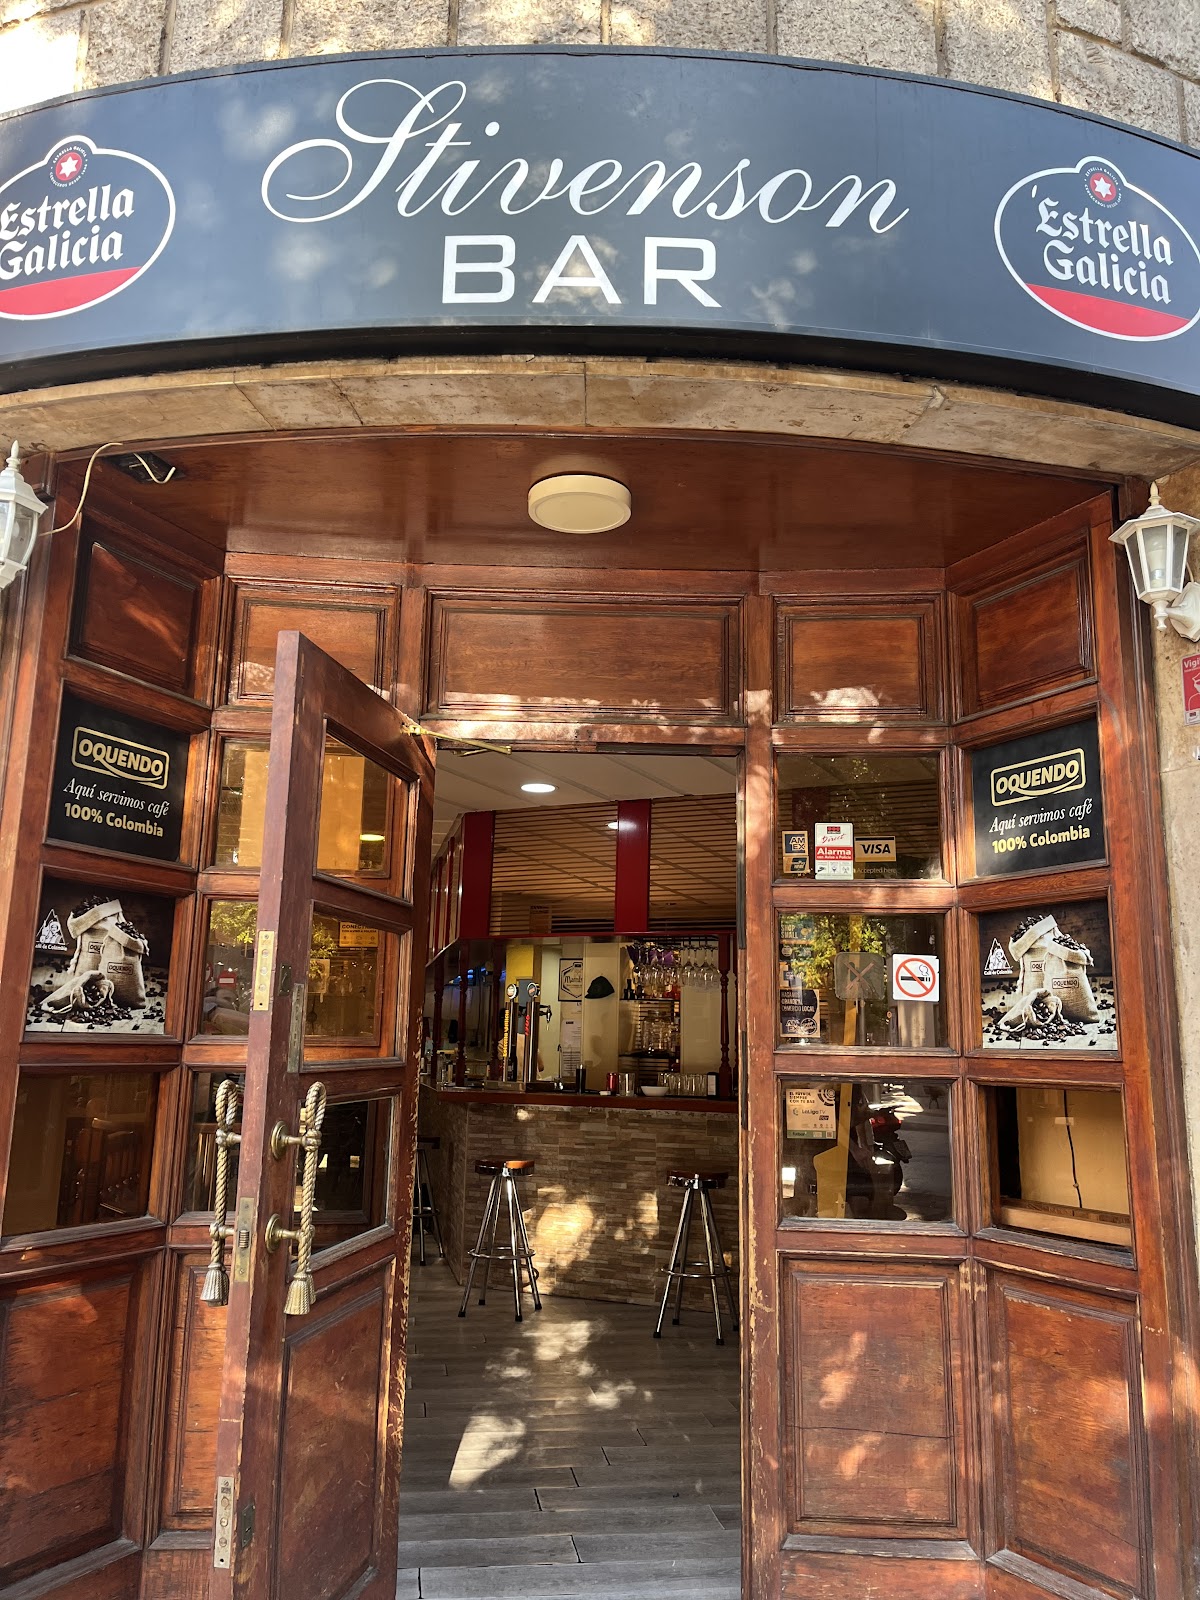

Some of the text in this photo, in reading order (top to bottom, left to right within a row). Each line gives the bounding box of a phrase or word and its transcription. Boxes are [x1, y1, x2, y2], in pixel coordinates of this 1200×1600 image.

[261, 78, 910, 234] Stivenson
[0, 184, 135, 241] Estrella
[1031, 185, 1174, 266] Estrella
[0, 225, 123, 280] Galicia
[442, 234, 722, 307] BAR
[1043, 239, 1172, 305] Galicia
[79, 738, 164, 779] OQUENDO
[996, 760, 1080, 796] OQUENDO
[63, 778, 171, 819] Aquí servimos café
[989, 798, 1093, 835] Aquí servimos café
[64, 803, 164, 837] 100% Colombia
[992, 825, 1091, 854] 100% Colombia
[860, 844, 890, 854] VISA
